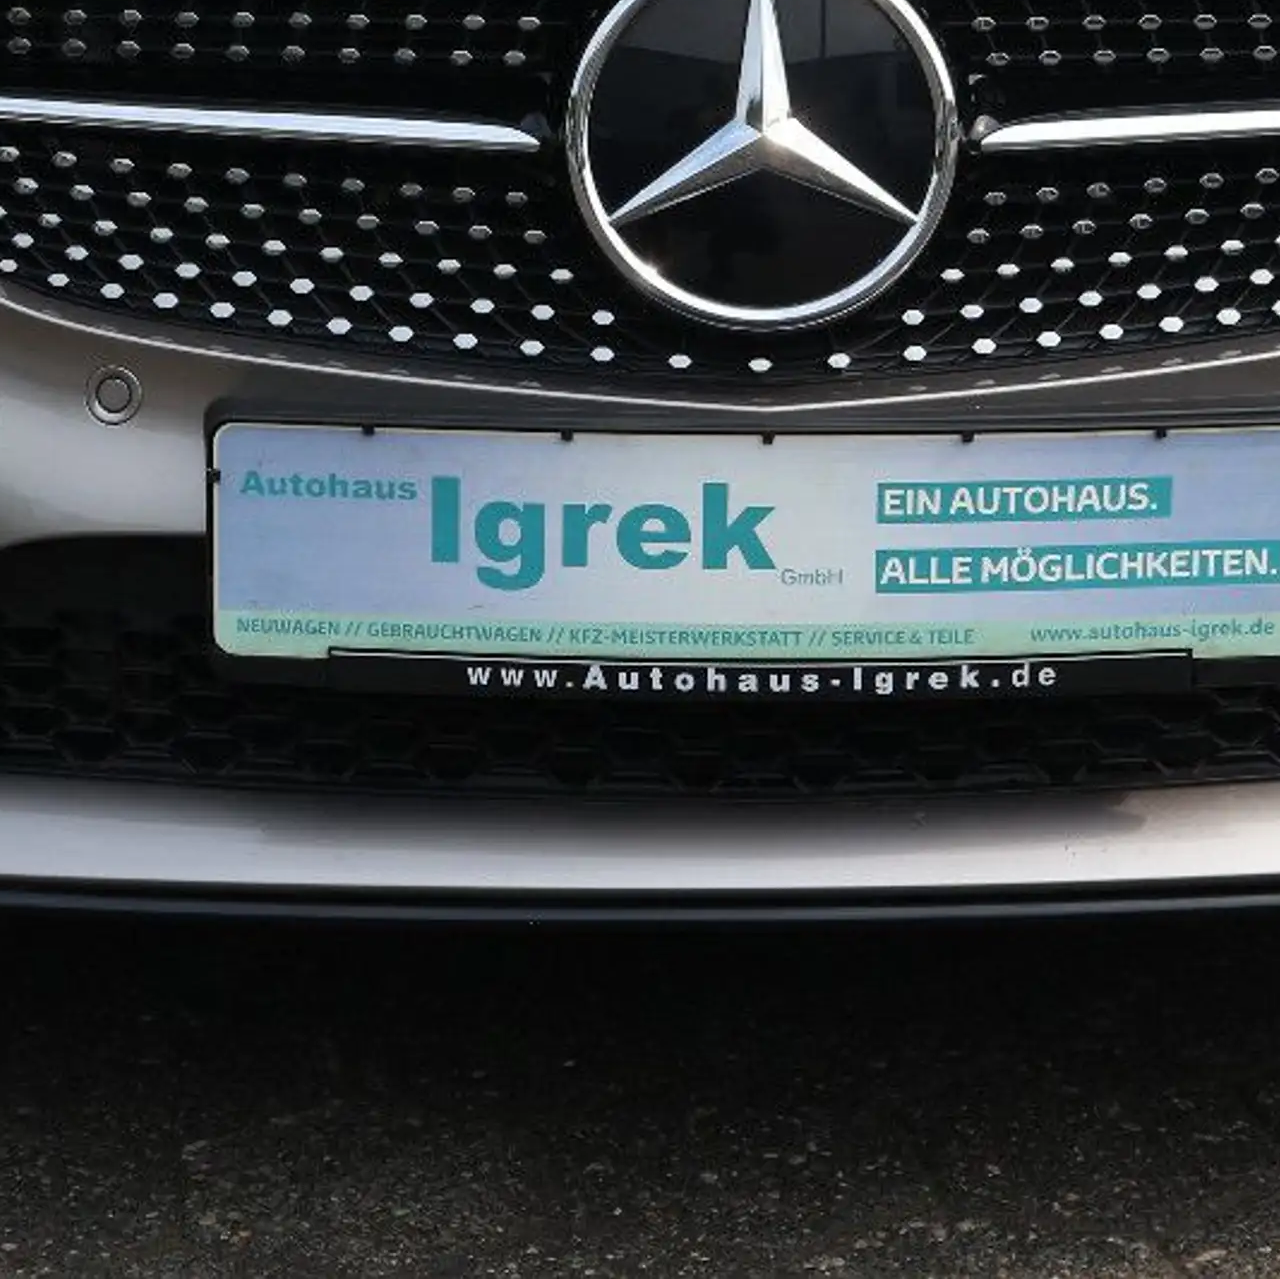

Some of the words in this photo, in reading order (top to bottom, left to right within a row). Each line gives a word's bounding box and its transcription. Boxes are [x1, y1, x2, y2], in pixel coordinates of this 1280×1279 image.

[883, 488, 941, 515] EIN
[949, 483, 1158, 514] AUTOHAUS.
[240, 469, 418, 501] Autohaus
[431, 476, 776, 591] Igrek
[781, 568, 843, 587] GmbH
[880, 555, 973, 585] ALLE
[980, 547, 1279, 584] MÖGLICHKEITEN.
[236, 617, 339, 636] NEUWAGEN
[369, 621, 542, 643] GEBRAUCHTWAGEN
[569, 626, 803, 647] KFZ-MEISTERWERKSTATT
[831, 630, 907, 646] SERVICE
[927, 628, 975, 645] TEILE
[1030, 618, 1276, 643] www.autohaus-igrek.de
[467, 665, 1057, 695] www.Autohaus-Igrek.de
